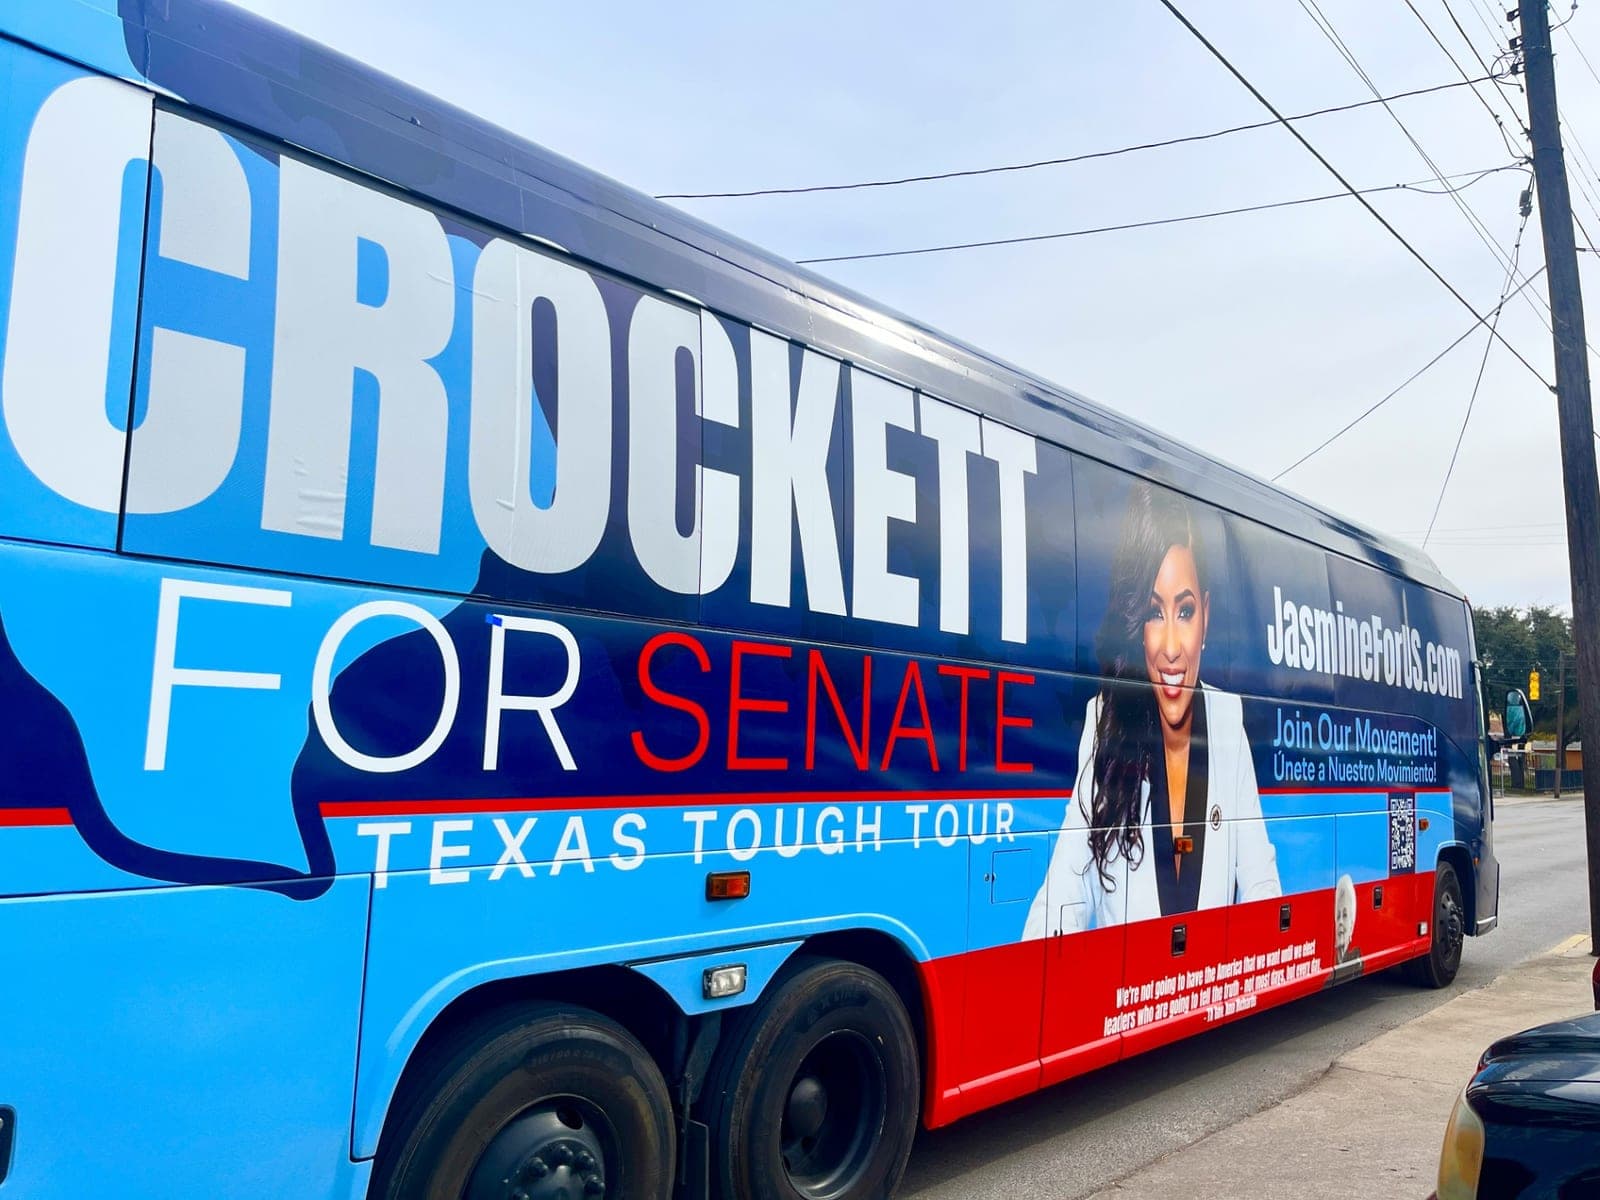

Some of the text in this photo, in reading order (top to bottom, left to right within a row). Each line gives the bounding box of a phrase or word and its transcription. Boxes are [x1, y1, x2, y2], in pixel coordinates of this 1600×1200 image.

[2, 76, 1038, 644] CROCKETT
[143, 577, 1036, 773] FOR SENATE
[1273, 707, 1437, 757] Join Our Movement!
[1273, 750, 1437, 783] Únete a Nuestro Movimiento!
[356, 802, 1016, 889] TEXAS TOUGH TOUR
[1104, 1011, 1136, 1036] leaders
[1137, 1005, 1154, 1026] who
[1155, 1002, 1168, 1020] are
[1169, 994, 1190, 1018] going
[1191, 991, 1199, 1009] to
[1200, 987, 1211, 1007] tell
[1212, 985, 1223, 1003] the
[1244, 975, 1255, 993] not
[1116, 986, 1139, 1008] We're
[1140, 980, 1154, 1001] not
[1155, 976, 1176, 999] going
[1178, 972, 1185, 991] to
[1186, 969, 1203, 989] have
[1204, 966, 1216, 984] the
[1217, 959, 1243, 980] America
[1244, 954, 1256, 973] that
[1256, 954, 1265, 970] we
[1266, 948, 1280, 967] want
[1294, 945, 1302, 959] we
